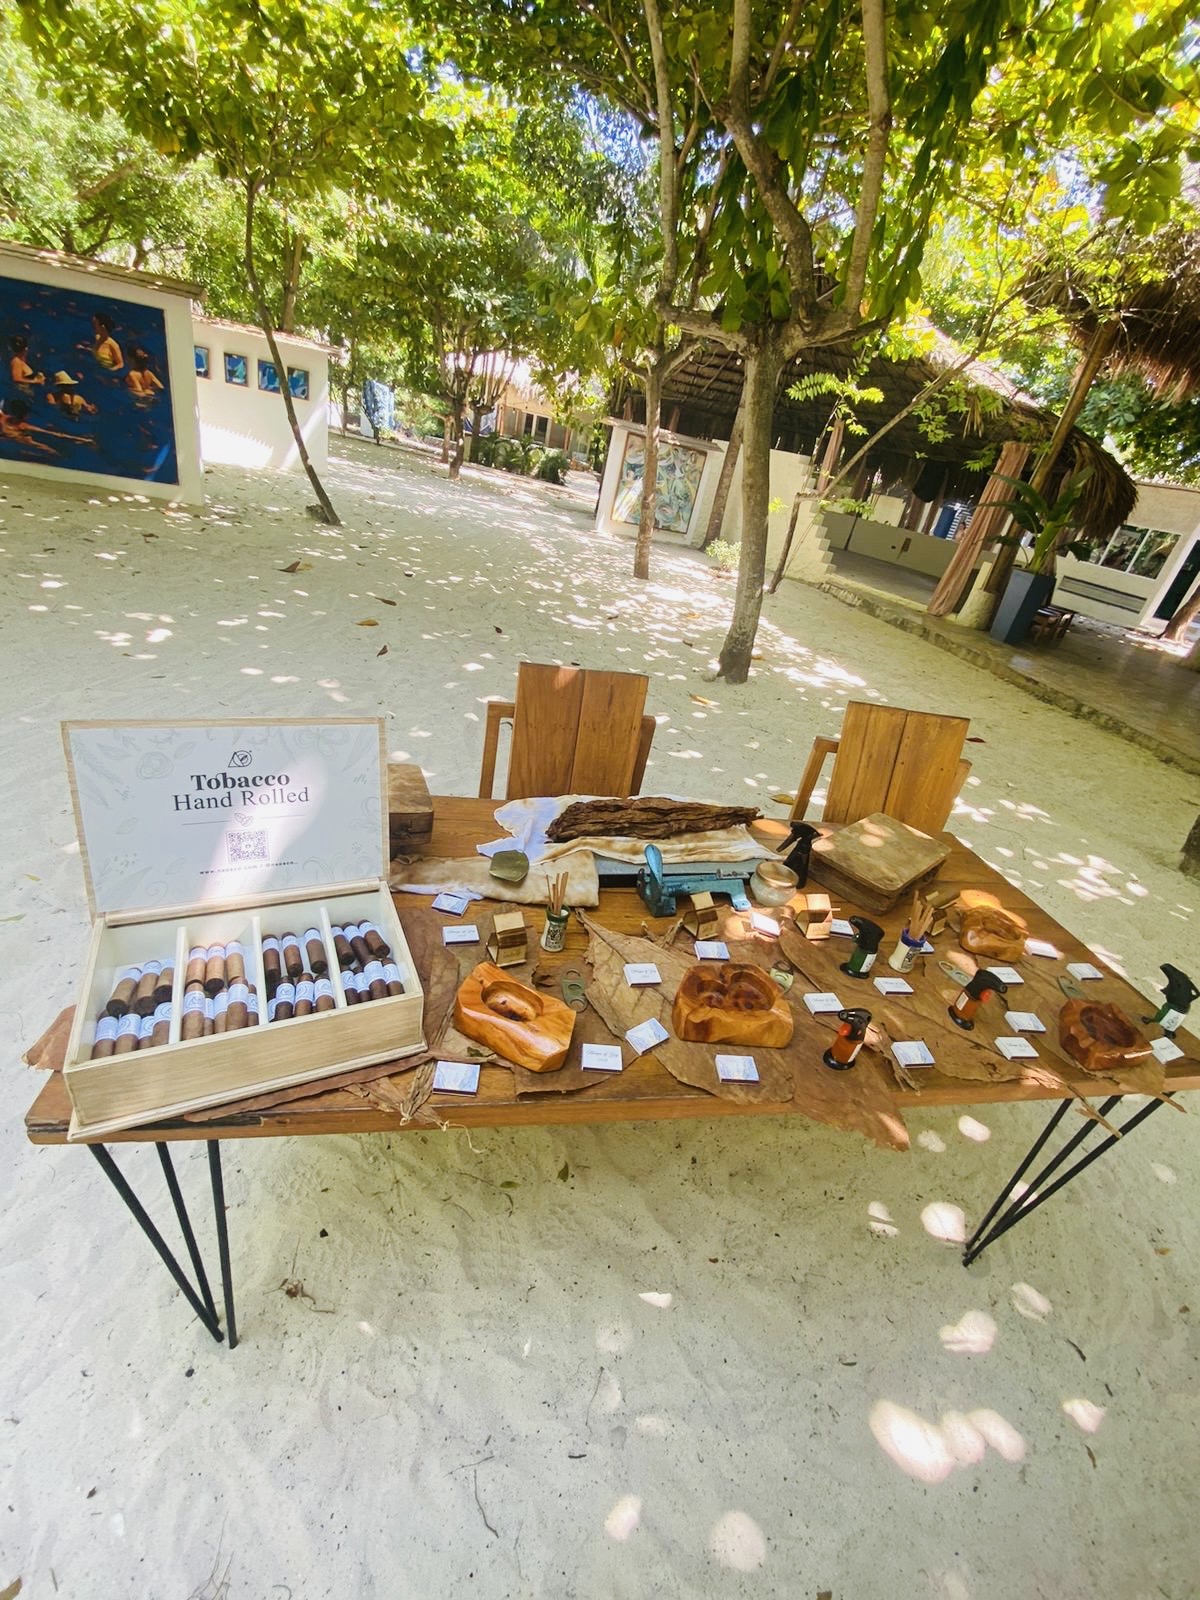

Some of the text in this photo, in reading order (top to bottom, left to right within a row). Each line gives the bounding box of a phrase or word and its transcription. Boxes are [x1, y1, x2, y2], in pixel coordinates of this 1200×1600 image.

[190, 772, 290, 791] Tobacco
[173, 787, 310, 811] Hand Rolled
